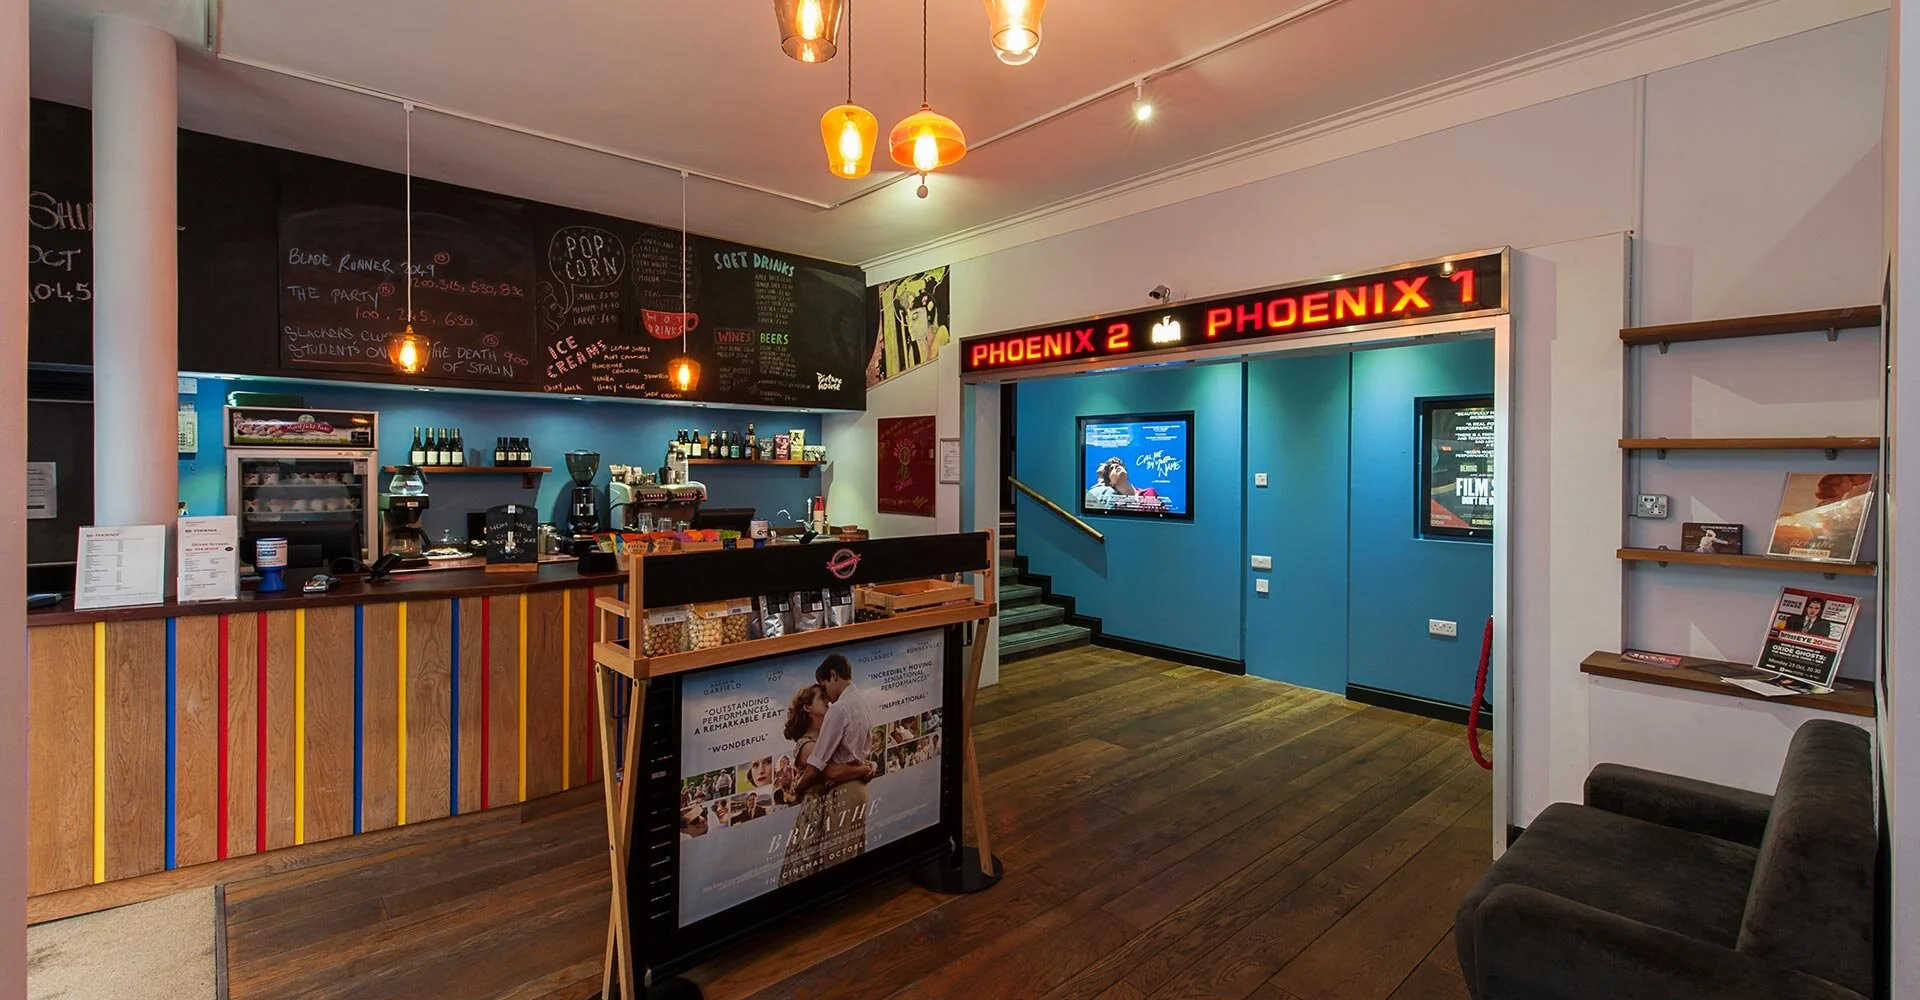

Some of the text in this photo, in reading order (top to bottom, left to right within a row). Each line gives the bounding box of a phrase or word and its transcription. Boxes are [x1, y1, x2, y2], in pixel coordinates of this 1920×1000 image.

[565, 234, 604, 260] POP
[289, 247, 333, 268] BLADE
[338, 254, 394, 275] RUNNER
[400, 262, 435, 277] 2049
[565, 257, 617, 280] CORN
[753, 253, 795, 278] DRINKS
[287, 285, 320, 302] THE
[331, 290, 379, 310] PARTY
[1206, 268, 1477, 338] PHOENIX 1
[645, 312, 683, 324] HOT
[647, 324, 684, 337] DRINKS
[717, 331, 752, 343] WINES
[759, 332, 789, 345] BEERS
[432, 341, 449, 359] THE
[457, 347, 497, 361] DEATH
[547, 335, 578, 360] ICE
[971, 322, 1130, 368] PHOENIX 2
[547, 338, 608, 379] CREAMS
[443, 362, 514, 378] OF STALIN
[816, 372, 842, 384] Picture
[1456, 477, 1488, 497] FILM
[858, 651, 894, 663] HOLLANDER
[906, 642, 940, 654] BONNEVILLE
[1772, 644, 1794, 654] OXIDE
[1768, 657, 1788, 667] Monday
[768, 675, 782, 683] FOY
[884, 669, 925, 684] SENSATIONAL
[703, 683, 742, 696] GARFIELD
[694, 728, 701, 736] A
[703, 714, 759, 734] REMARKABLE
[767, 797, 883, 855] BREATHE
[782, 857, 825, 879] CINEMAS
[828, 839, 868, 861] OCTOBER
